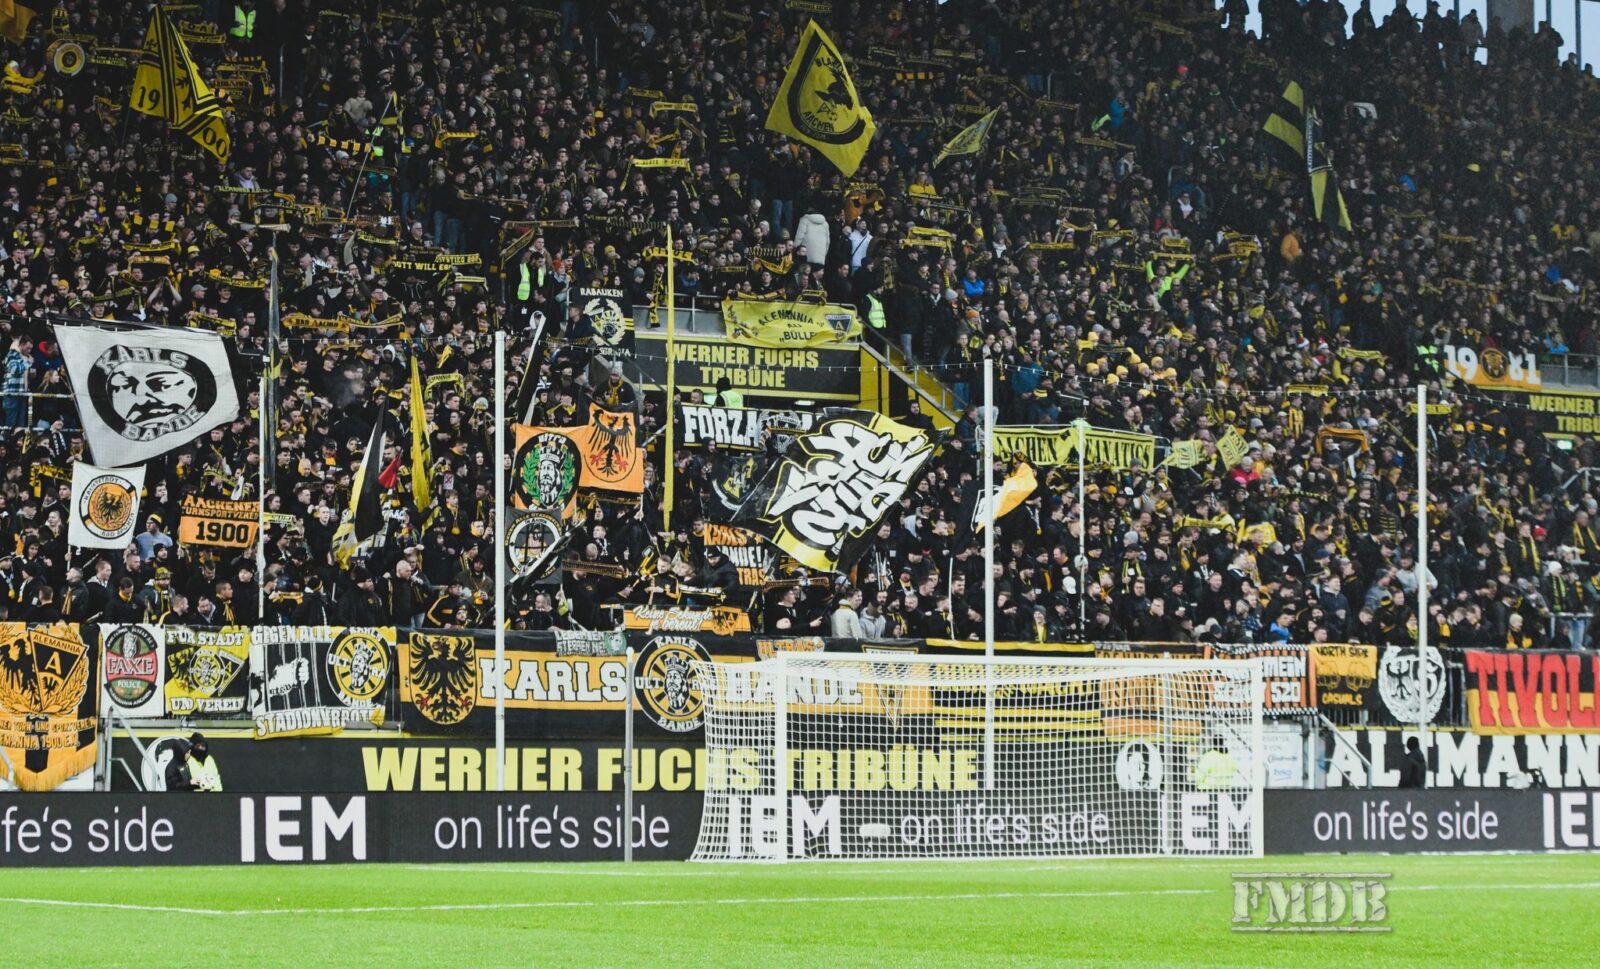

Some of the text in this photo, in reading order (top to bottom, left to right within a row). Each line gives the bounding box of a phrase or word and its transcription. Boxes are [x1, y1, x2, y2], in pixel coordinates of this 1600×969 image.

[137, 85, 161, 111] 19
[202, 127, 228, 158] 00
[580, 287, 624, 298] RABAUKEN
[95, 347, 190, 375] KARLS
[665, 341, 820, 368] WERNER FUCHS
[1443, 345, 1478, 380] 19
[699, 365, 786, 388] TRIBÜNE
[1530, 394, 1595, 414] WERNER
[121, 404, 206, 442] BANDE
[682, 405, 761, 448] FORZA
[183, 494, 260, 513] AACHENER
[195, 520, 250, 544] 1900
[32, 633, 82, 654] ALEMANNIA
[197, 631, 245, 646] STADT
[252, 624, 334, 645] GEGEN ALLE
[654, 635, 698, 651] KARLS
[45, 650, 62, 676] A
[107, 655, 156, 676] FAXE
[479, 657, 628, 703] KARLS
[657, 714, 702, 732] BANDE
[362, 742, 979, 792] WERNER FUCHS TRIBÜNE
[87, 805, 174, 853] side
[240, 795, 367, 863] IEM
[434, 816, 483, 850] on
[592, 805, 670, 849] side
[900, 814, 942, 847] on
[1042, 803, 1110, 844] side
[1313, 811, 1353, 842] on
[1437, 801, 1499, 841] side
